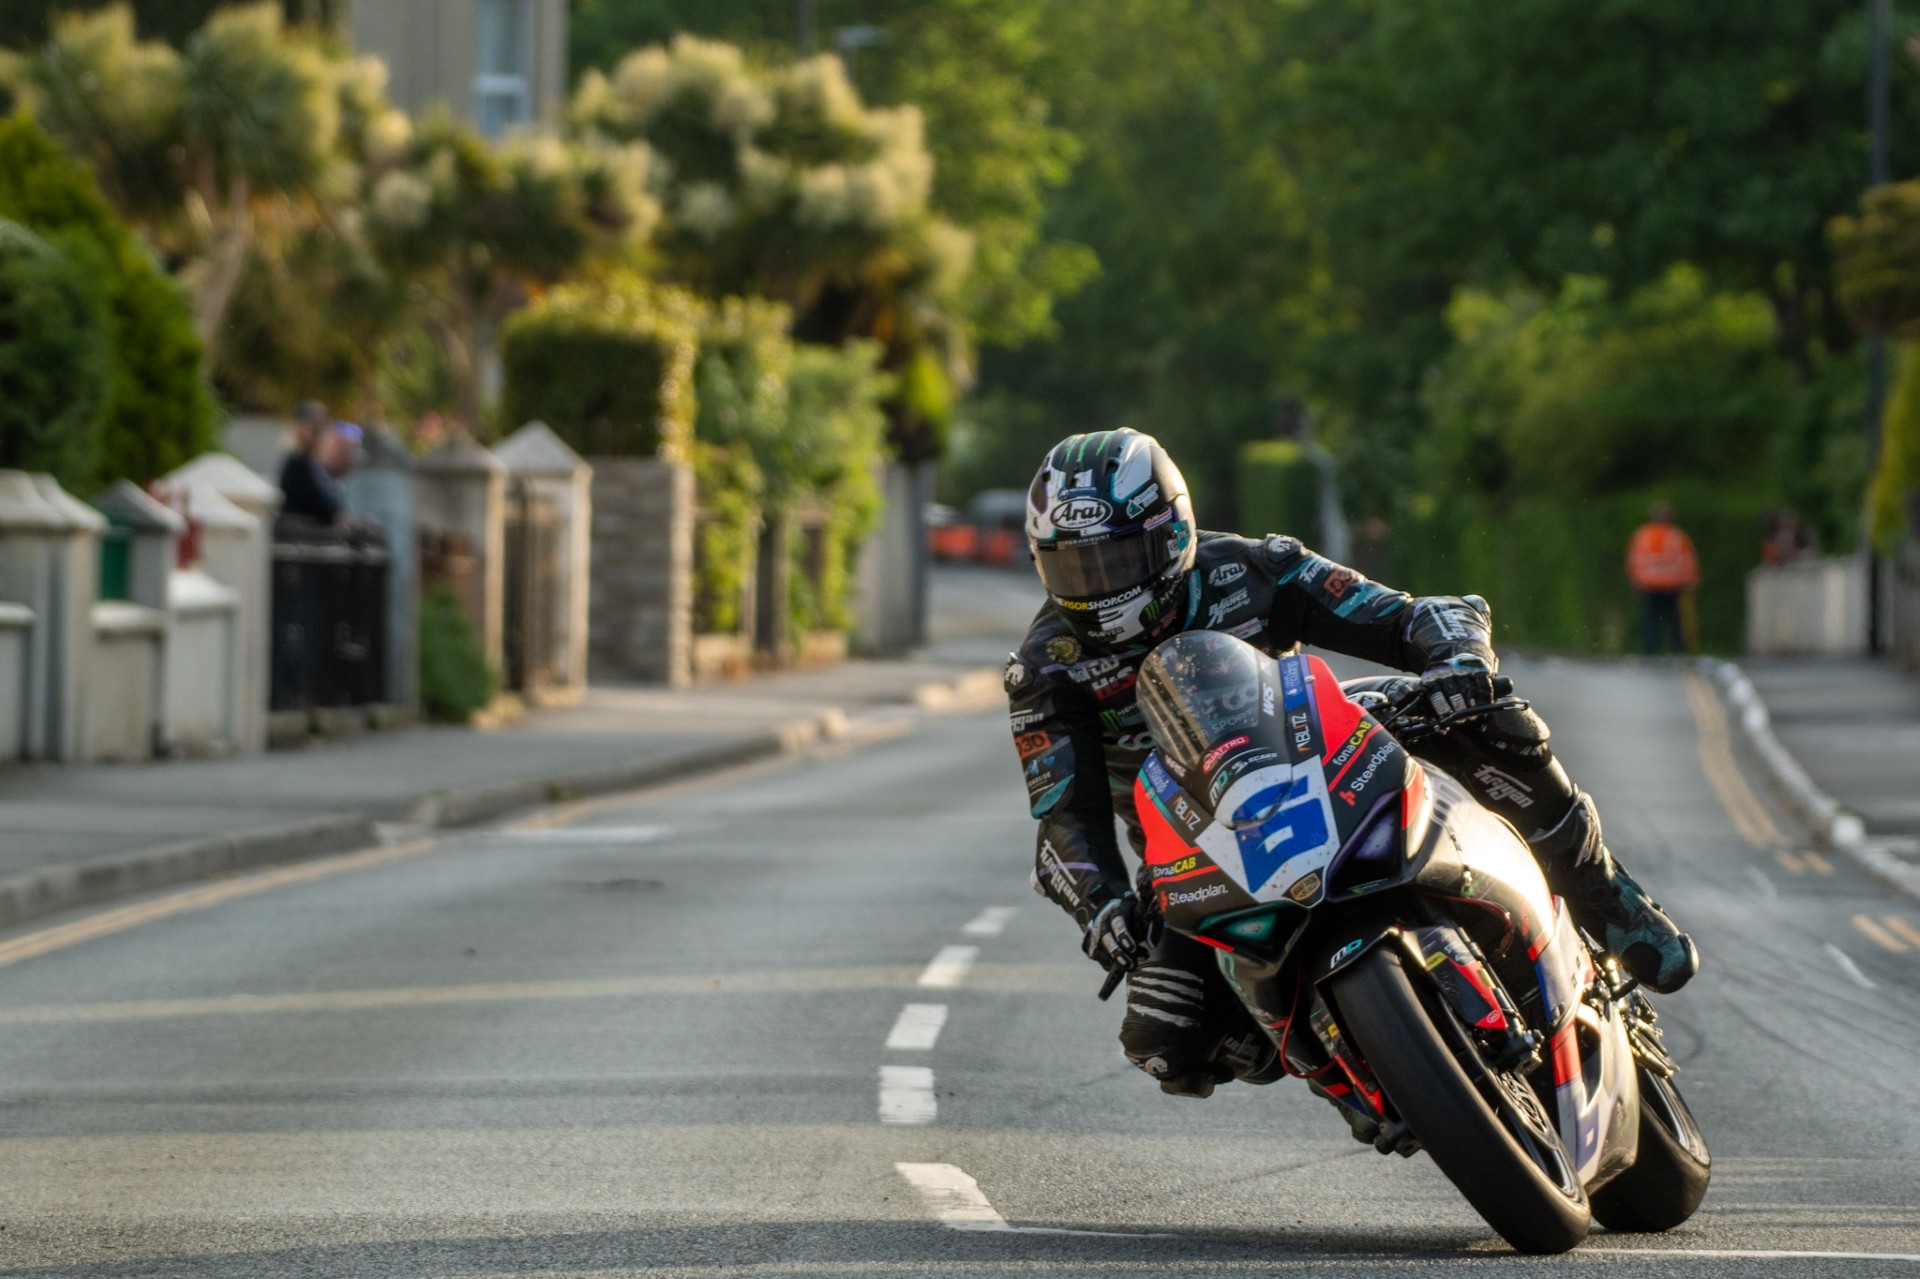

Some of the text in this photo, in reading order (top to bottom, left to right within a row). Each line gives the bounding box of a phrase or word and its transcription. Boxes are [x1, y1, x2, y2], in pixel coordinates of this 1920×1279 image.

[1056, 501, 1104, 522] Arai
[1209, 564, 1245, 585] Arai
[1203, 736, 1247, 769] QUATTRO
